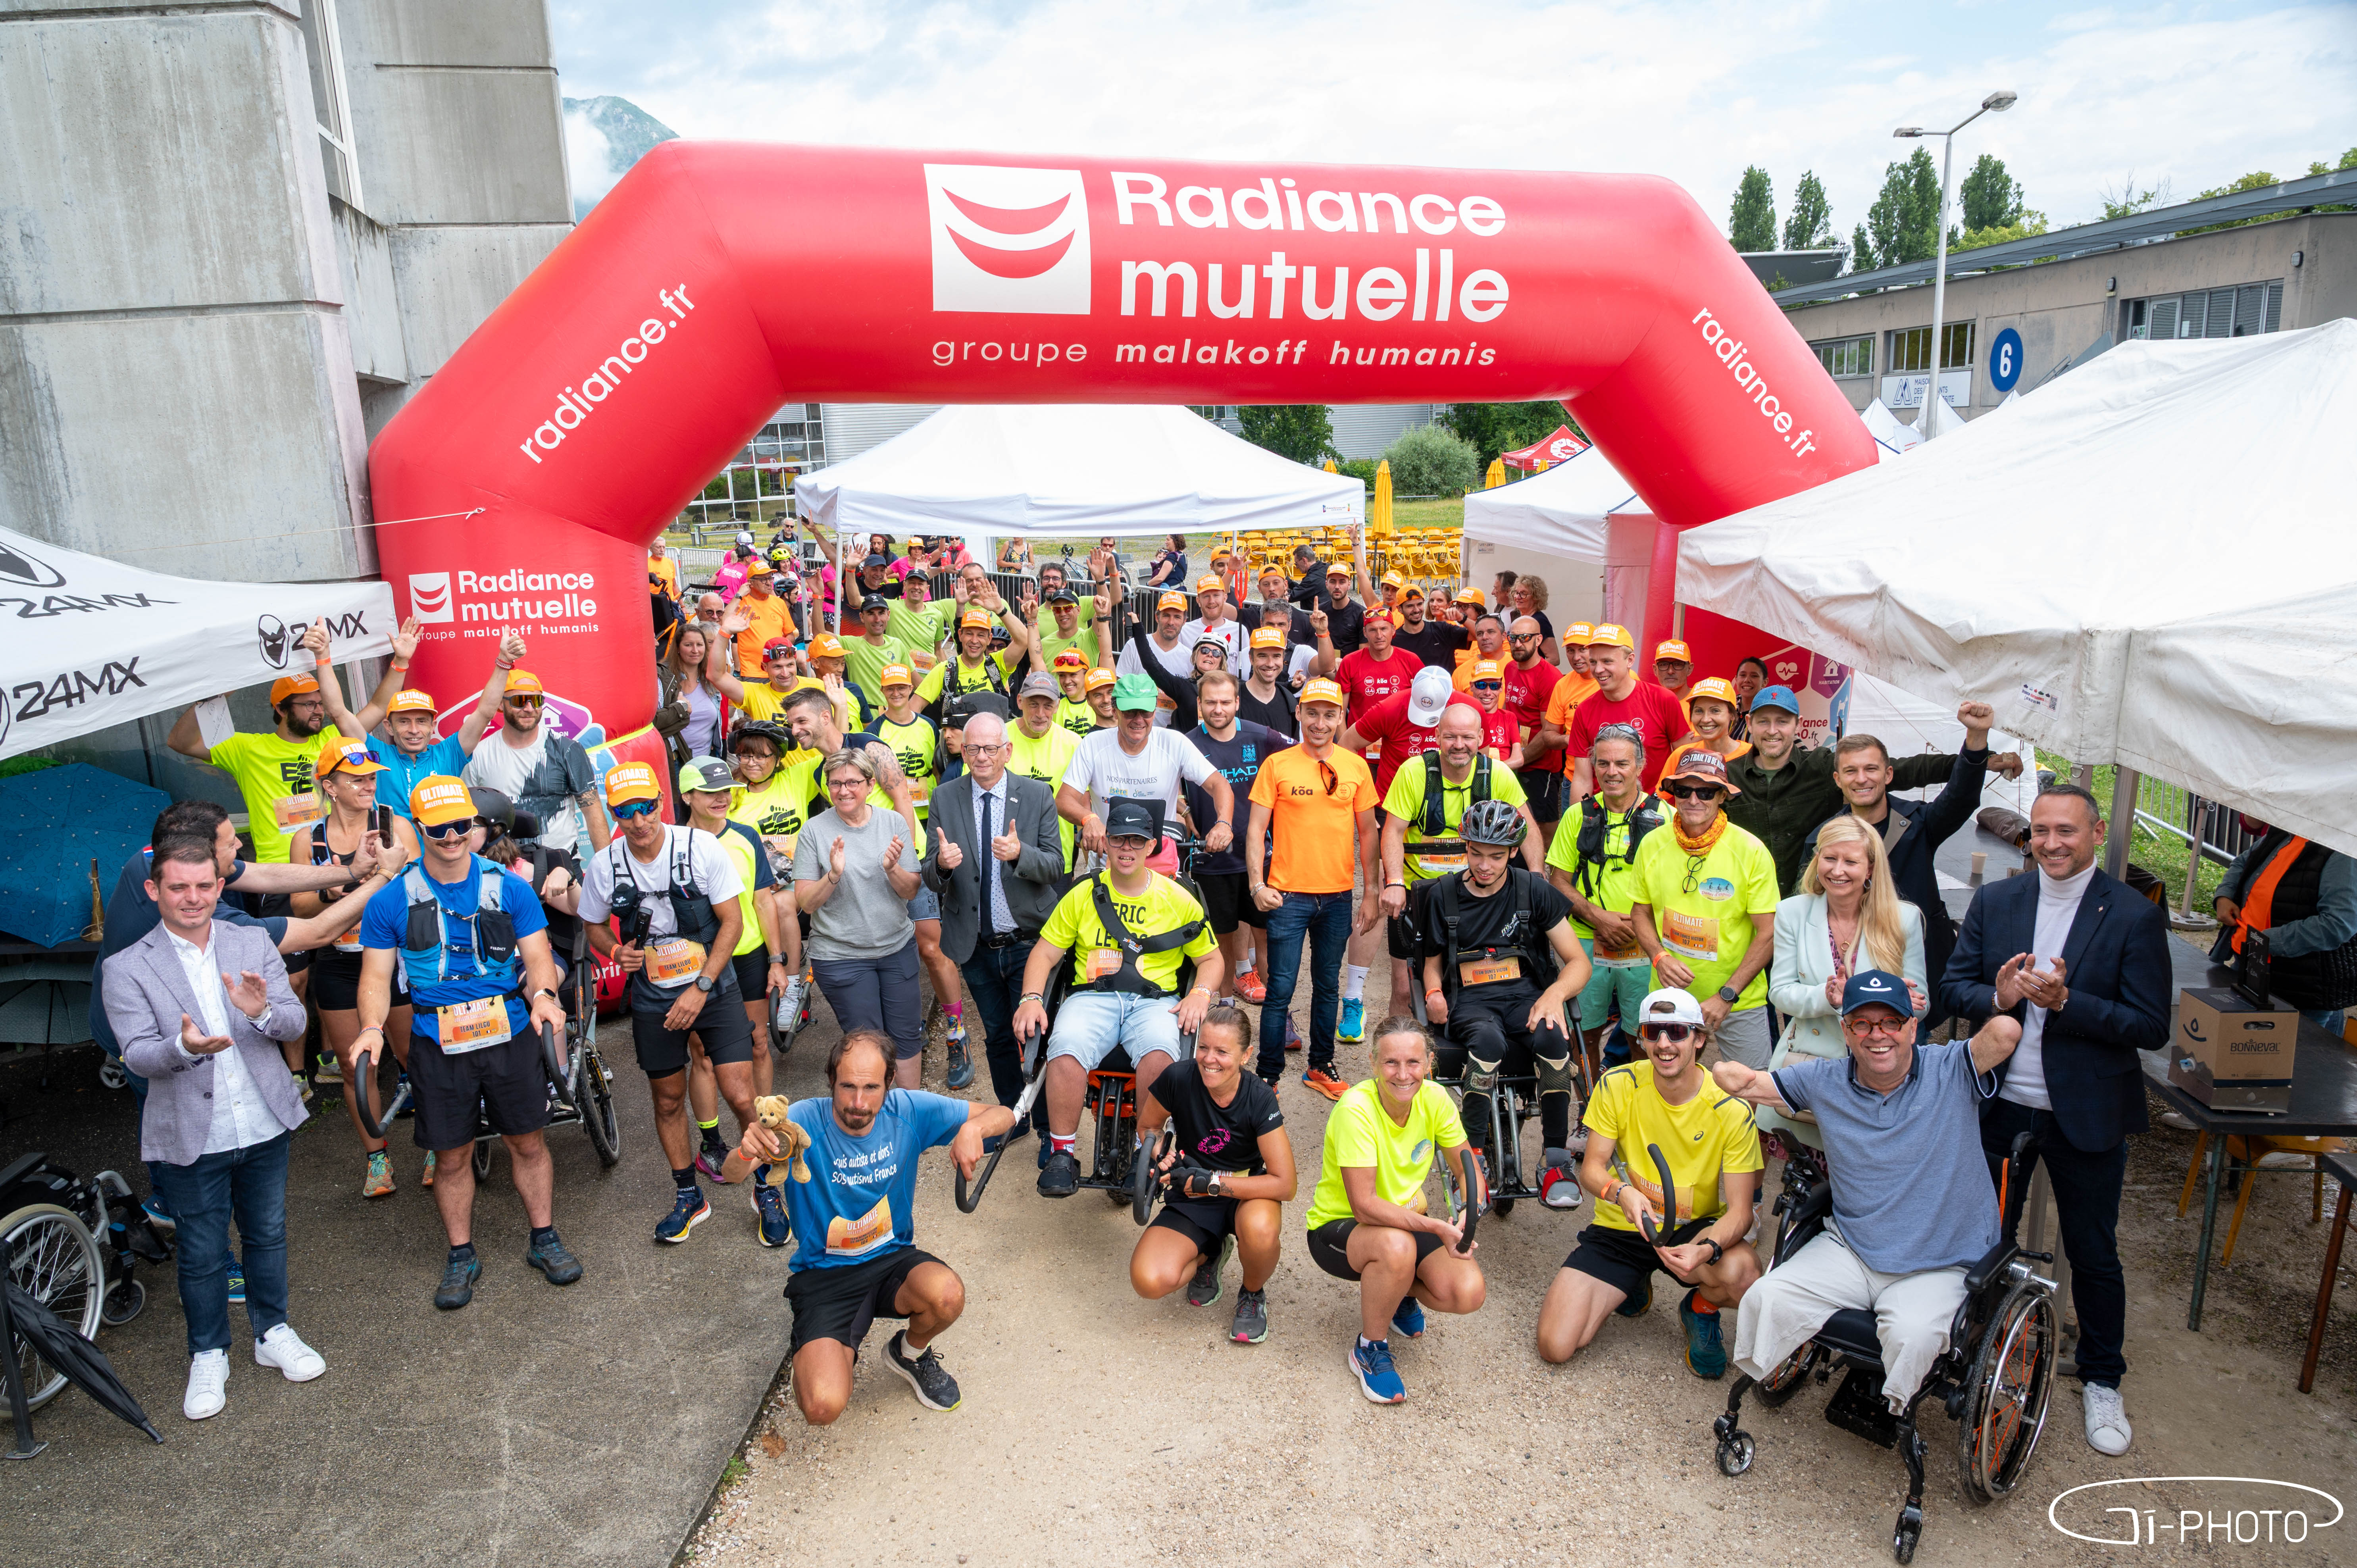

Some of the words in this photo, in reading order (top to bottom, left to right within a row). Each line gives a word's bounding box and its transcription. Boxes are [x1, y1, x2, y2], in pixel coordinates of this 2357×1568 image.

[1110, 171, 1506, 237] Radiance
[1119, 248, 1510, 322] mutuelle
[932, 340, 1087, 367] groupe
[1116, 339, 1307, 364] malakoff
[1329, 341, 1496, 366] humanis
[1999, 343, 2013, 378] 6
[520, 283, 695, 464] radiance.fr
[1692, 307, 1816, 457] radiance.fr
[458, 568, 595, 594] Radiance
[1200, 577, 1220, 585] ULTIMATE
[462, 593, 597, 621] mutuelle
[967, 612, 988, 620] ULTIMATE
[291, 610, 369, 652] 2MX
[541, 623, 599, 634] humanis
[1255, 629, 1281, 639] ULTIMATE
[1593, 625, 1619, 636] ULTIMATE
[1659, 642, 1685, 651] ULTIMATE
[883, 666, 908, 675] ULTIMATE
[1475, 662, 1497, 671] ULTIMATE
[1088, 669, 1112, 681] ULTIMATE
[13, 656, 147, 722] 24MX
[1307, 681, 1338, 693] ULTIMATE
[1694, 679, 1726, 691] ULTIMATE
[396, 691, 430, 704] ULTIMATE
[1689, 753, 1704, 762] TRAIL
[1704, 754, 1711, 763] TO
[1711, 757, 1718, 766] BE
[609, 768, 650, 786] ULTIMATE
[1106, 775, 1118, 783] NOS
[1119, 776, 1158, 785] PARTENAIRES
[419, 784, 465, 803] ULTIMATE
[1110, 786, 1127, 795] isère
[1291, 786, 1313, 796] kõa
[286, 793, 314, 805] ULTIMATE
[1673, 912, 1703, 927] ULTIMATE
[657, 940, 689, 957] ULTIMATE
[1099, 950, 1123, 959] ULTIMA
[677, 958, 691, 968] LILOU
[460, 1024, 475, 1033] TEAM
[849, 1152, 869, 1168] autiste
[870, 1150, 877, 1164] et
[878, 1145, 890, 1161] alors
[889, 1141, 894, 1154] !
[832, 1171, 847, 1185] SOS
[847, 1172, 873, 1186] autisme
[874, 1164, 897, 1182] France
[1640, 1177, 1663, 1194] ULTIM
[847, 1207, 878, 1231] ULTIMATE
